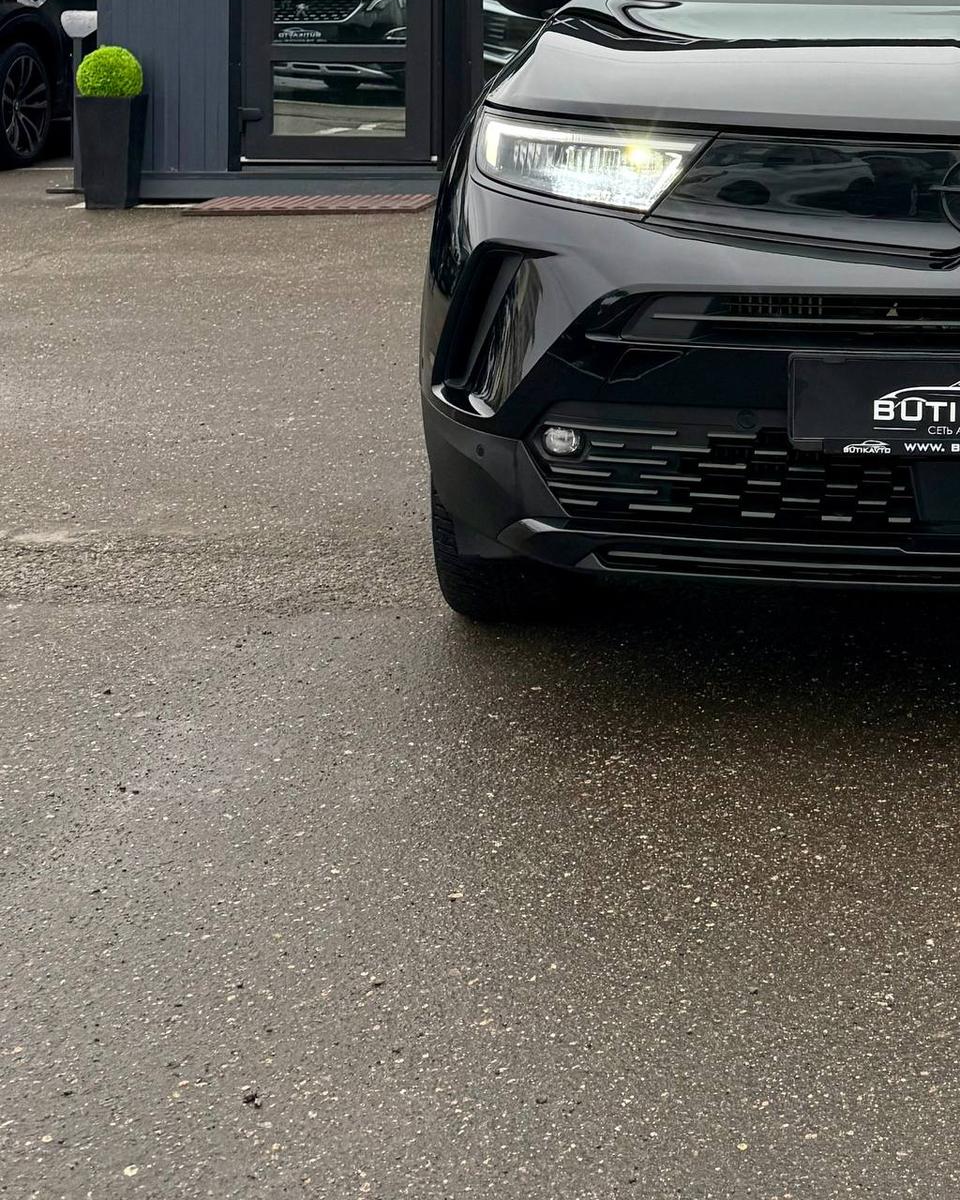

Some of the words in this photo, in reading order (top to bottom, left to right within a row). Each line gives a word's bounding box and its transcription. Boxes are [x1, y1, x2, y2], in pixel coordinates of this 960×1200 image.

[927, 425, 954, 434] СЕТЬ
[843, 446, 891, 454] BUTIKAVTO
[904, 443, 945, 452] WWW.
